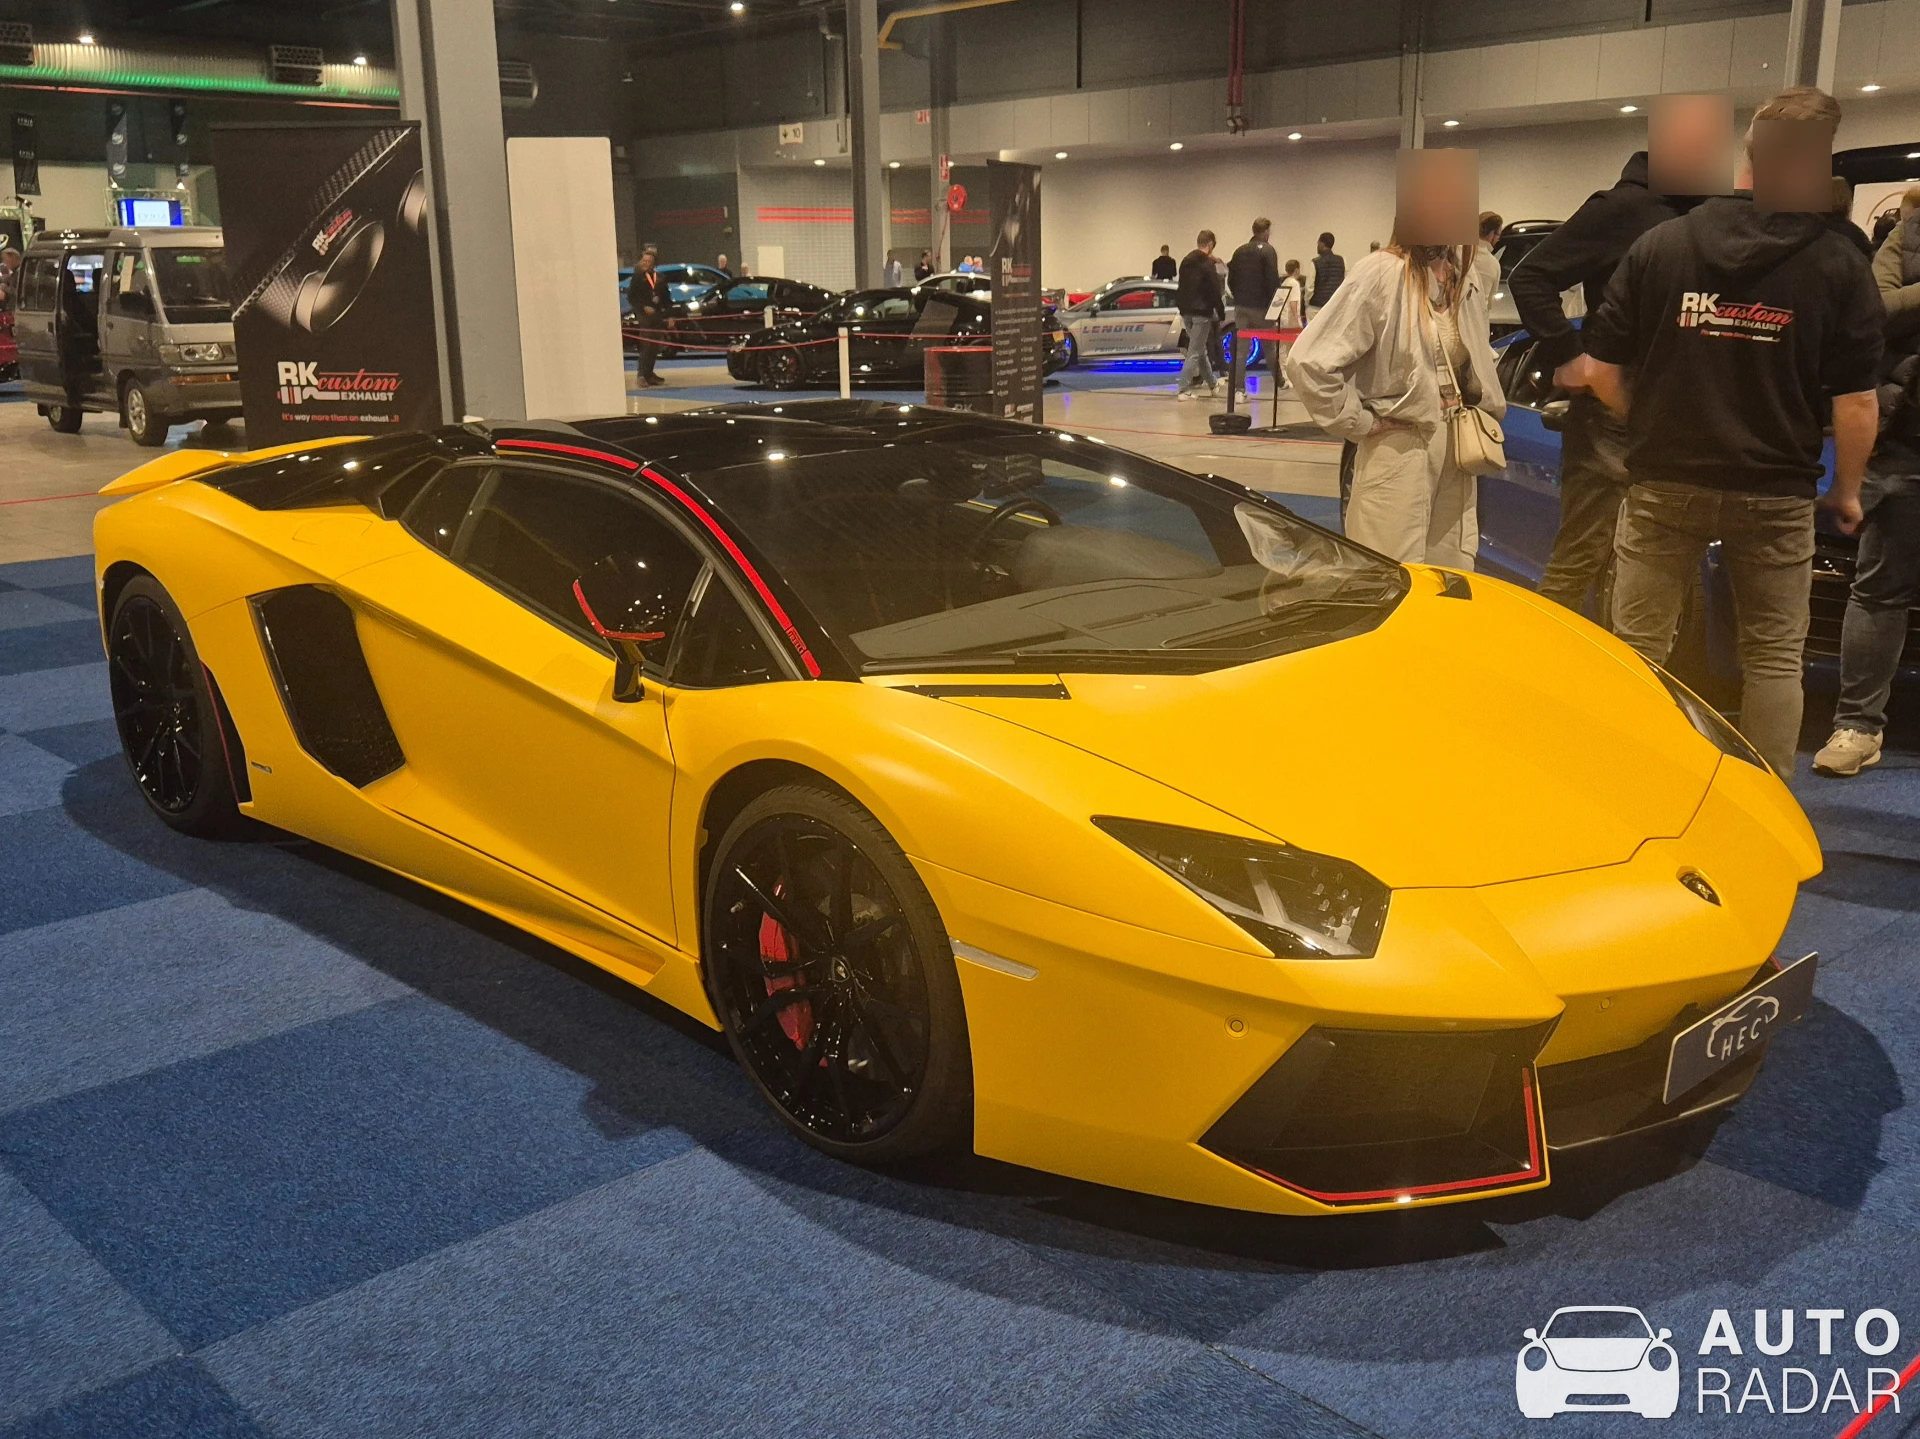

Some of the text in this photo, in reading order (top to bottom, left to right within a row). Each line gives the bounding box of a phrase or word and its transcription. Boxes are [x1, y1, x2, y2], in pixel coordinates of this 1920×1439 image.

[793, 127, 801, 139] 10
[312, 230, 328, 251] RK
[1002, 257, 1013, 274] RK
[1681, 292, 1795, 325] RK custom
[1734, 320, 1783, 333] EXHAUST
[277, 361, 403, 392] RK custom
[341, 391, 395, 401] EXHAUST
[295, 414, 310, 423] way
[360, 413, 390, 423] exhaust
